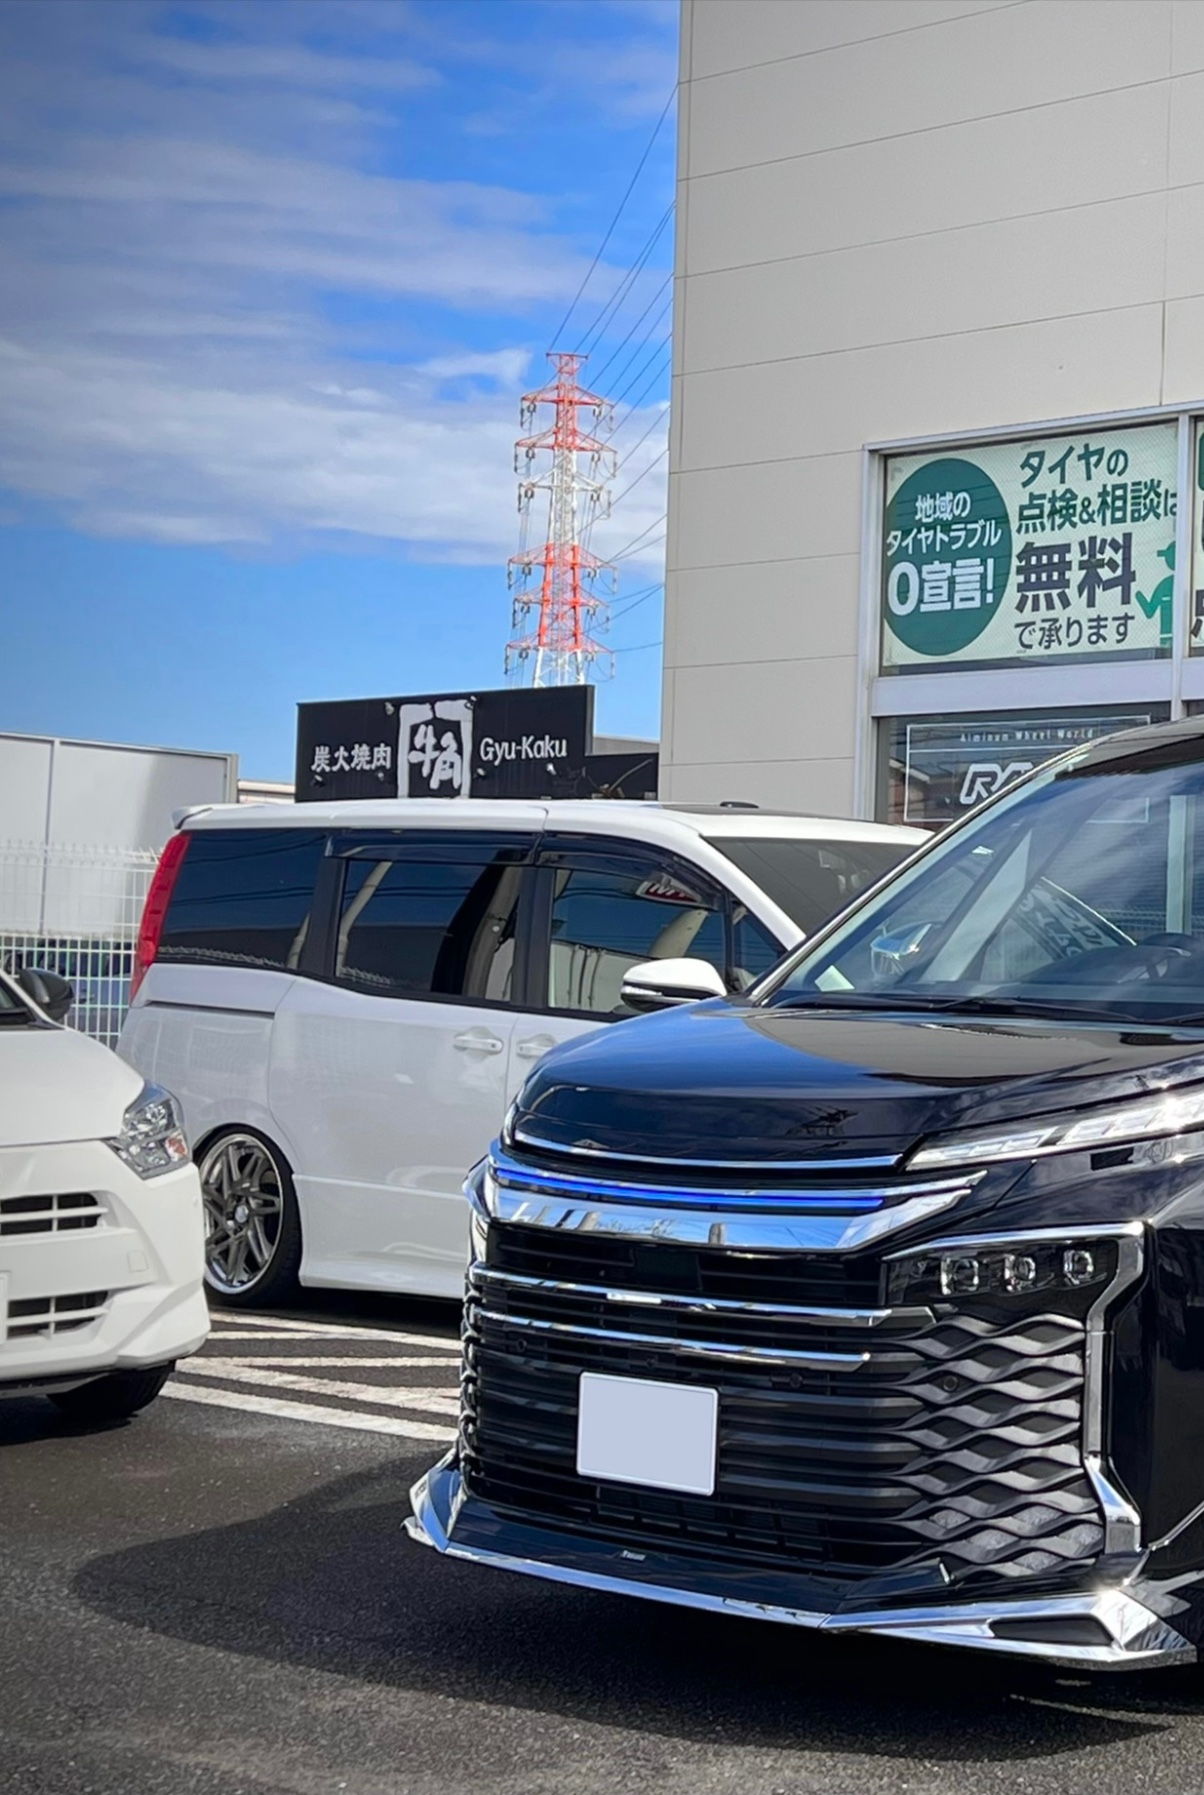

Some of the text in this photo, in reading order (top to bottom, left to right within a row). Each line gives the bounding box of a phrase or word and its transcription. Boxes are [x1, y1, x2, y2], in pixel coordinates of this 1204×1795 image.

[1019, 442, 1129, 488] タイヤの
[915, 491, 971, 523] 地域の
[886, 519, 1002, 557] タイヤトラブル
[887, 557, 995, 616] 0宣言!
[1014, 532, 1136, 614] 無料
[1014, 611, 1136, 650] で承ります
[480, 736, 567, 765] Gyu-Kaku
[1015, 729, 1051, 740] Wheel
[1057, 728, 1093, 739] World
[310, 742, 392, 773] 炭火焼肉
[408, 724, 462, 790] 牛角
